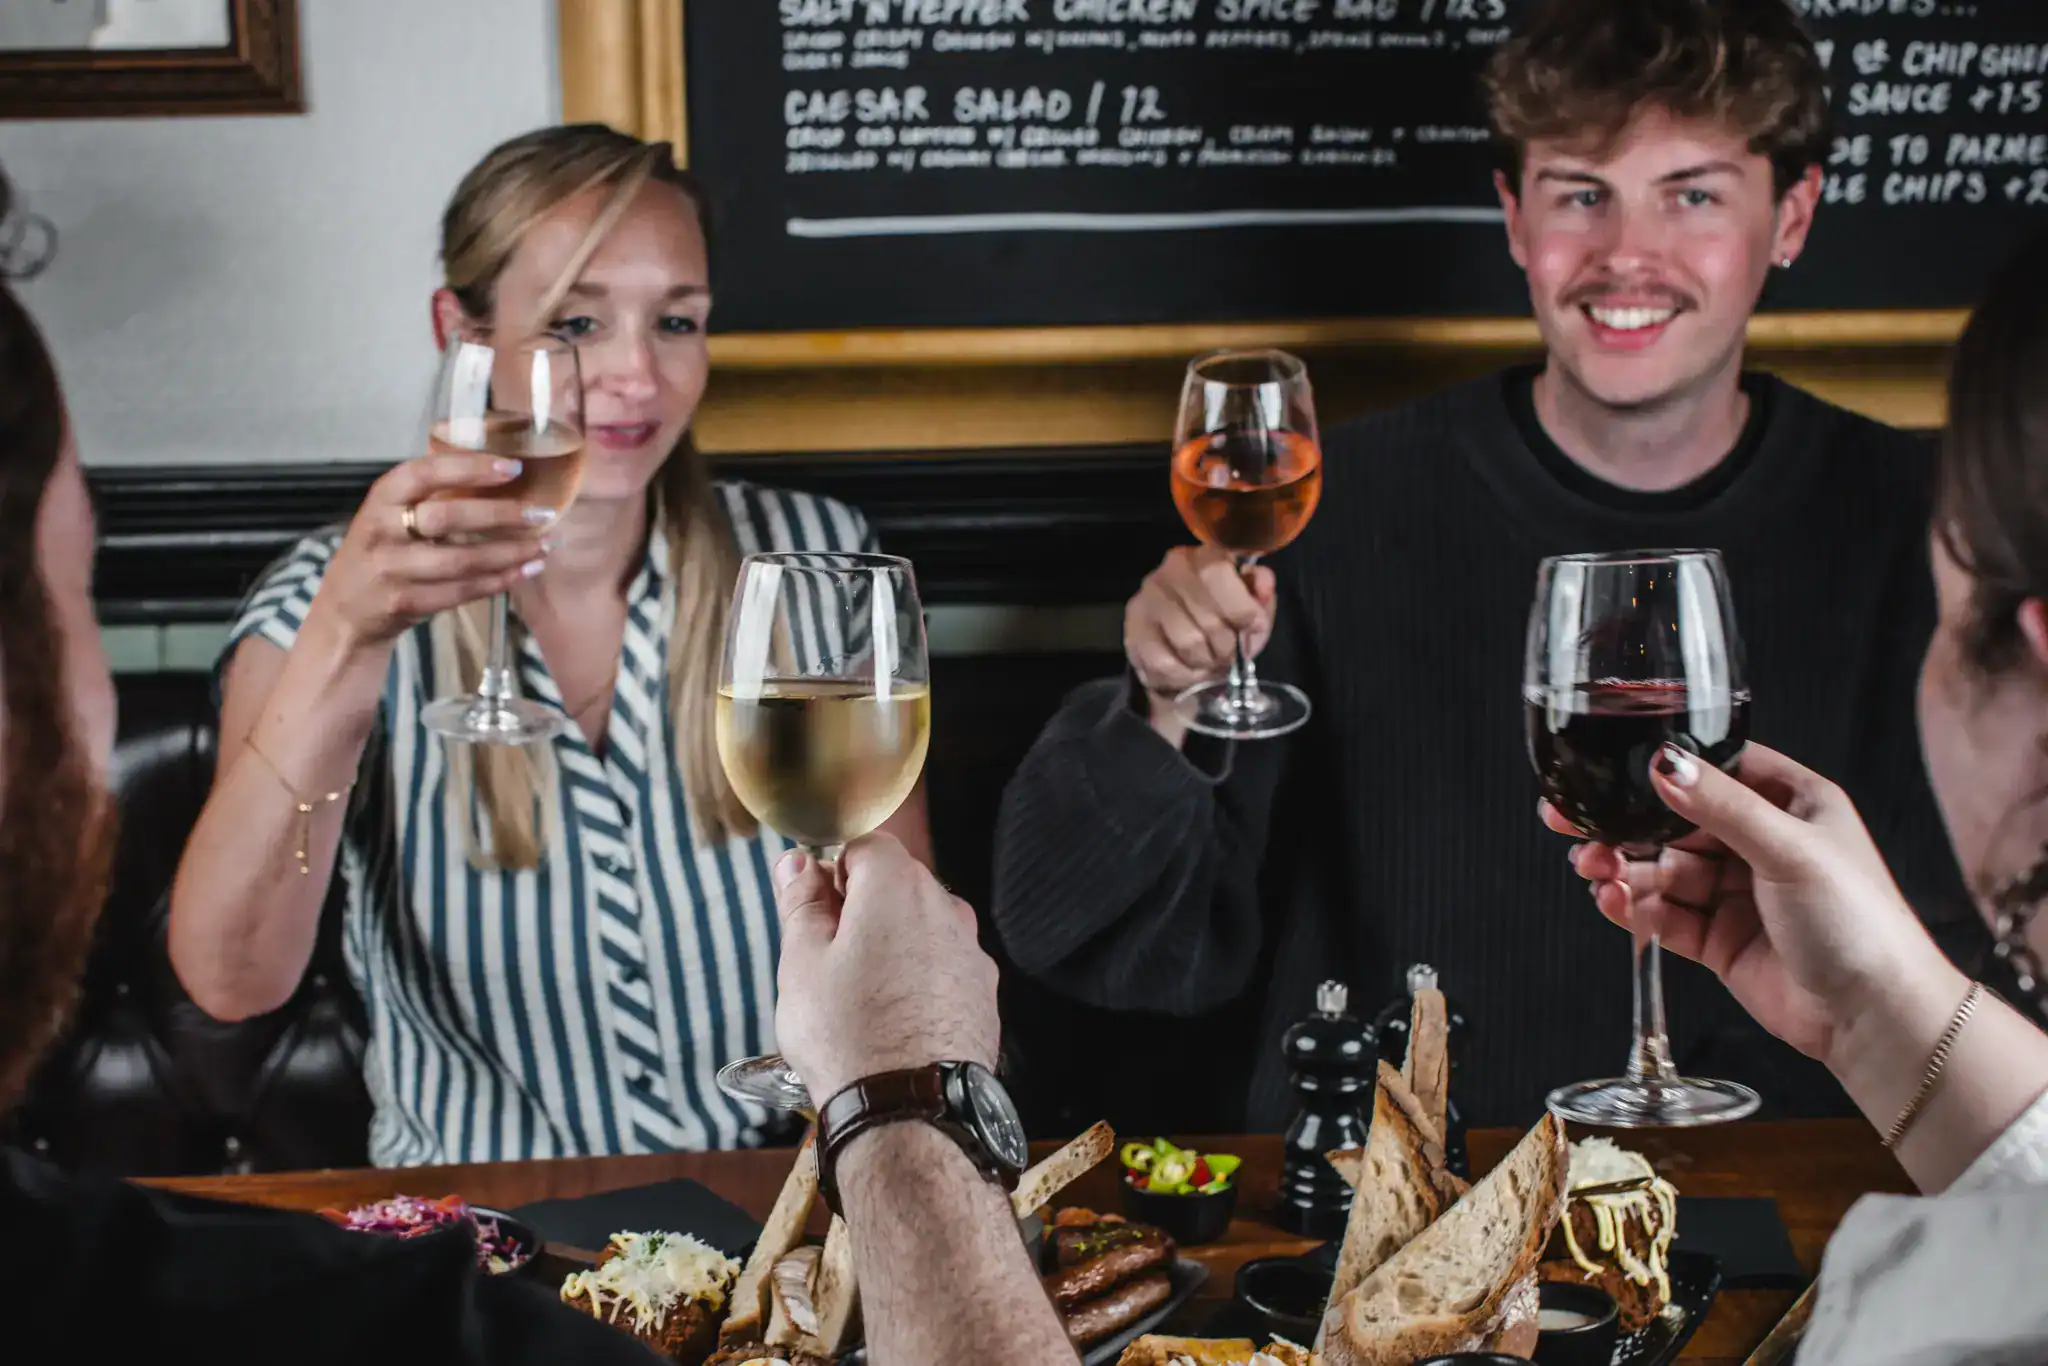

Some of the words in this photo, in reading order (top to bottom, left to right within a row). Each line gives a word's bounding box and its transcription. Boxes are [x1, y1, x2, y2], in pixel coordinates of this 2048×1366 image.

[1053, 0, 1198, 24] CHICKEN
[1214, 0, 1320, 23] SPICE
[784, 85, 930, 125] CAESAR
[953, 85, 1072, 123] SALAD
[1848, 81, 1951, 116] SAUCE
[1889, 133, 1929, 166] TO
[1883, 170, 1987, 205] CHIPS
